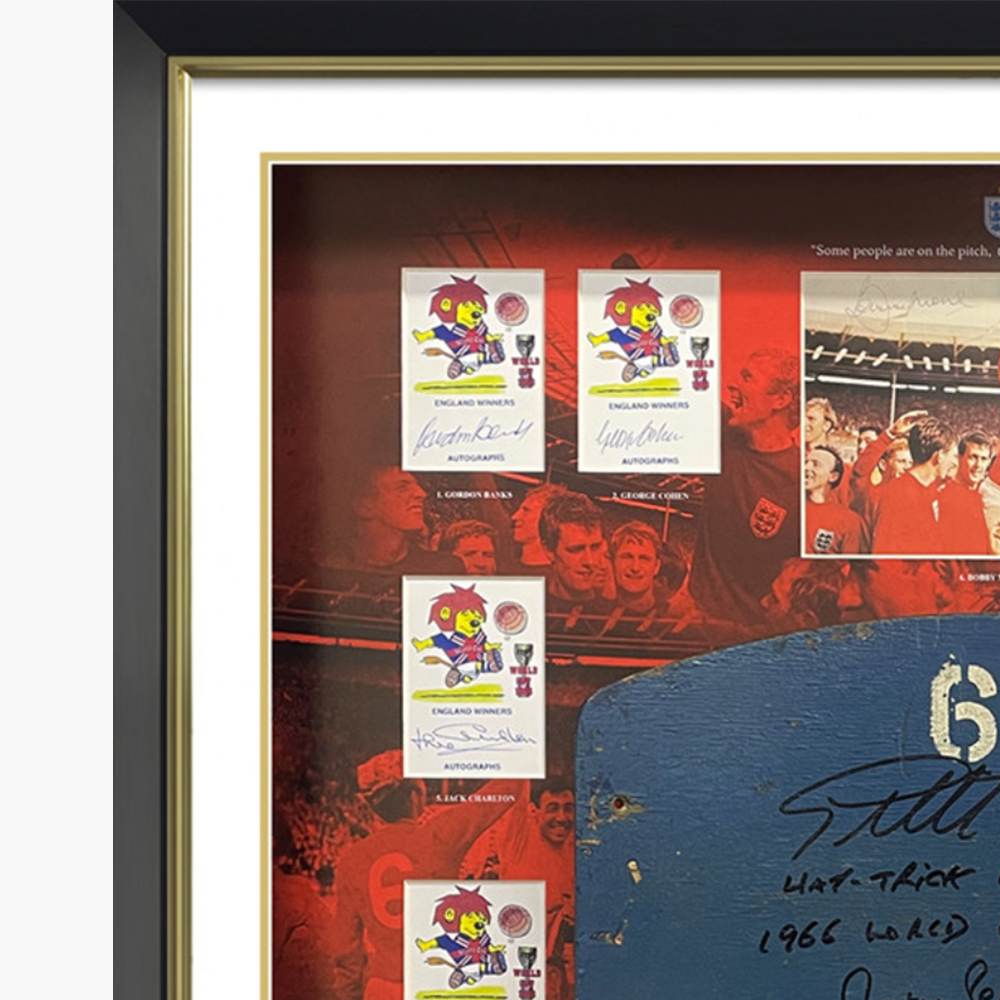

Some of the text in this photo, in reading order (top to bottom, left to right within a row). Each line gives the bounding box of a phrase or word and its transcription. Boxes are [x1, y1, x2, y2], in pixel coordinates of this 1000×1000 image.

[853, 244, 894, 260] people
[895, 248, 914, 257] are
[917, 248, 933, 257] on
[936, 244, 955, 257] the
[958, 244, 992, 260] pitch,
[434, 399, 516, 408] ENGLAND WINNERS
[608, 401, 690, 410] ENGLAND WINNERS
[447, 454, 506, 462] AUTOGRAPHS
[621, 457, 680, 465] AUTOGRAPHS
[444, 491, 482, 499] GORDON
[484, 491, 513, 499] BANKS
[620, 492, 656, 500] GEORGE
[658, 492, 689, 500] COHEN
[967, 573, 995, 582] BOBBY
[431, 707, 513, 716] ENGLAND WINNERS
[443, 763, 502, 771] AUTOGRAPHS
[444, 794, 467, 802] JACK
[468, 794, 515, 802] CHARLTON
[759, 917, 842, 953] 1966
